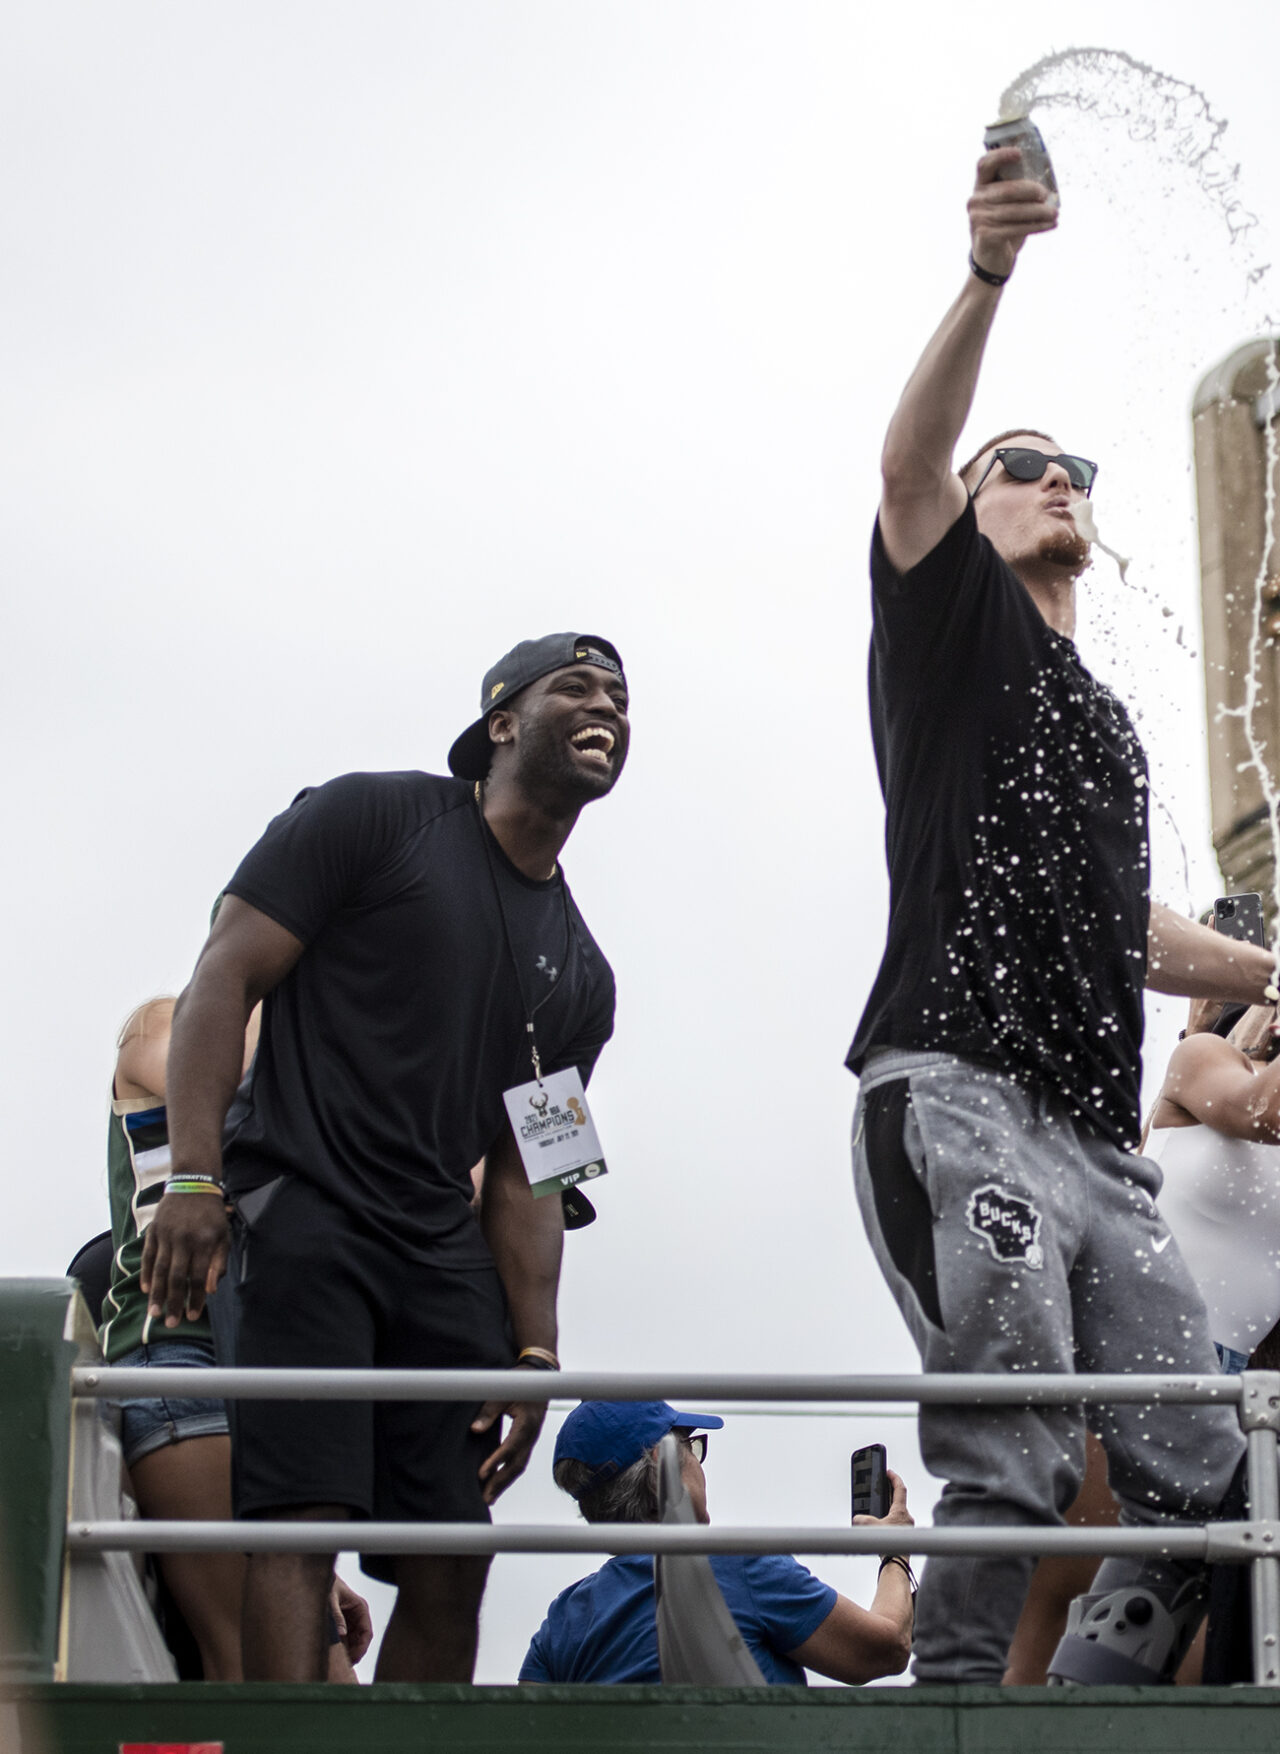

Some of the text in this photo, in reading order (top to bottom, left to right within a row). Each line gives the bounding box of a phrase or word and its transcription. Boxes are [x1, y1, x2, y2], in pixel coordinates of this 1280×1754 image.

[520, 1109, 575, 1138] CHAMPIONS
[561, 1173, 580, 1185] VIP
[980, 1202, 1032, 1240] BUCKS
